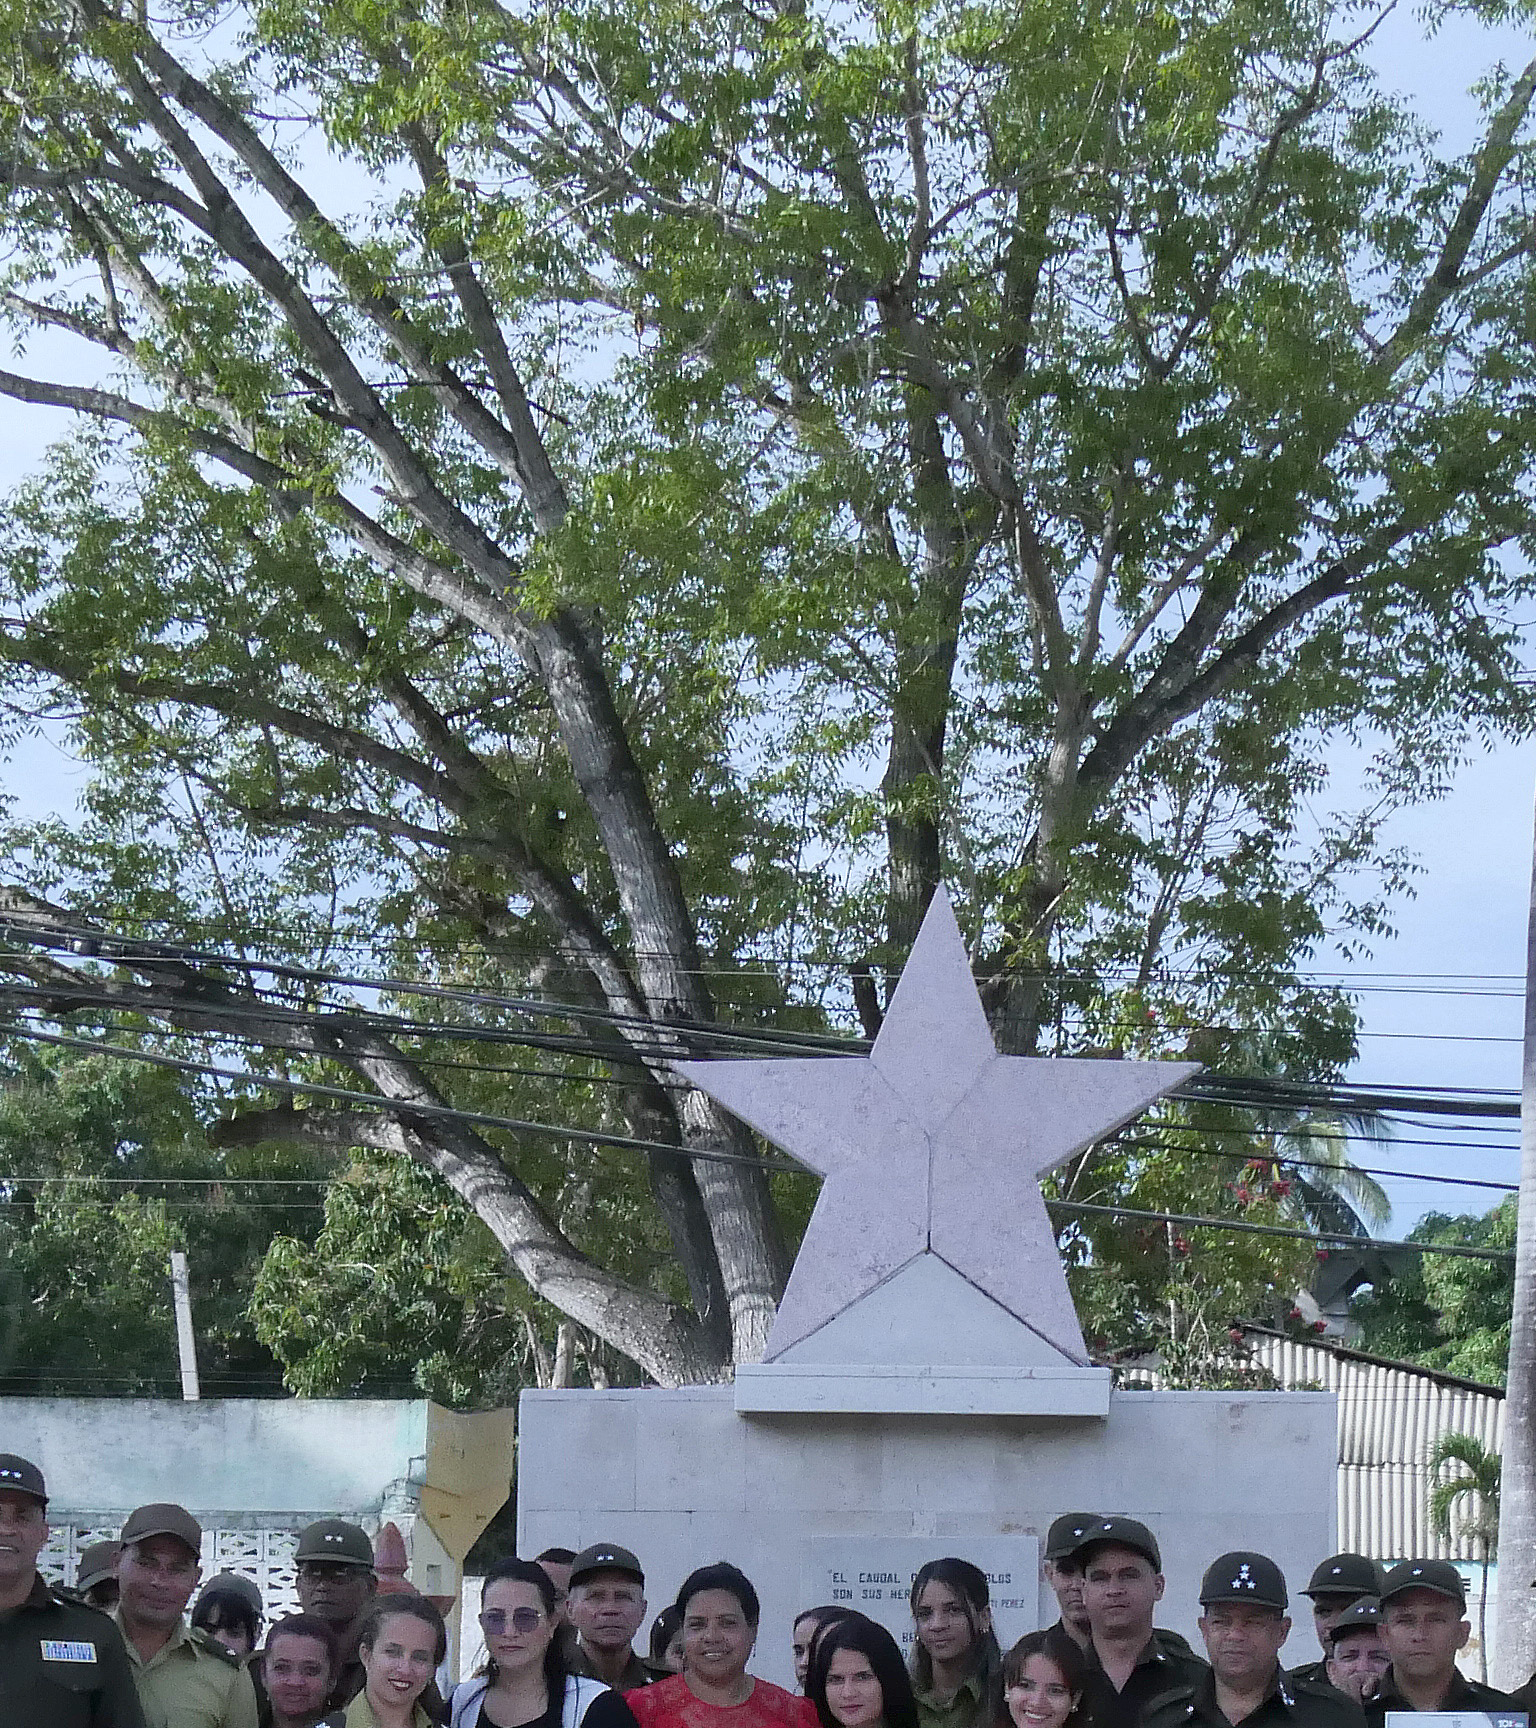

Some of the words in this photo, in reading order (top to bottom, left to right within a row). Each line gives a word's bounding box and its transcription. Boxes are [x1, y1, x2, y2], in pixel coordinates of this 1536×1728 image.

[859, 1572, 900, 1583] CAUDAL
[984, 1573, 1011, 1584] BLOS
[832, 1588, 853, 1600] SON
[861, 1588, 882, 1600] SUS
[890, 1588, 911, 1600] HER
